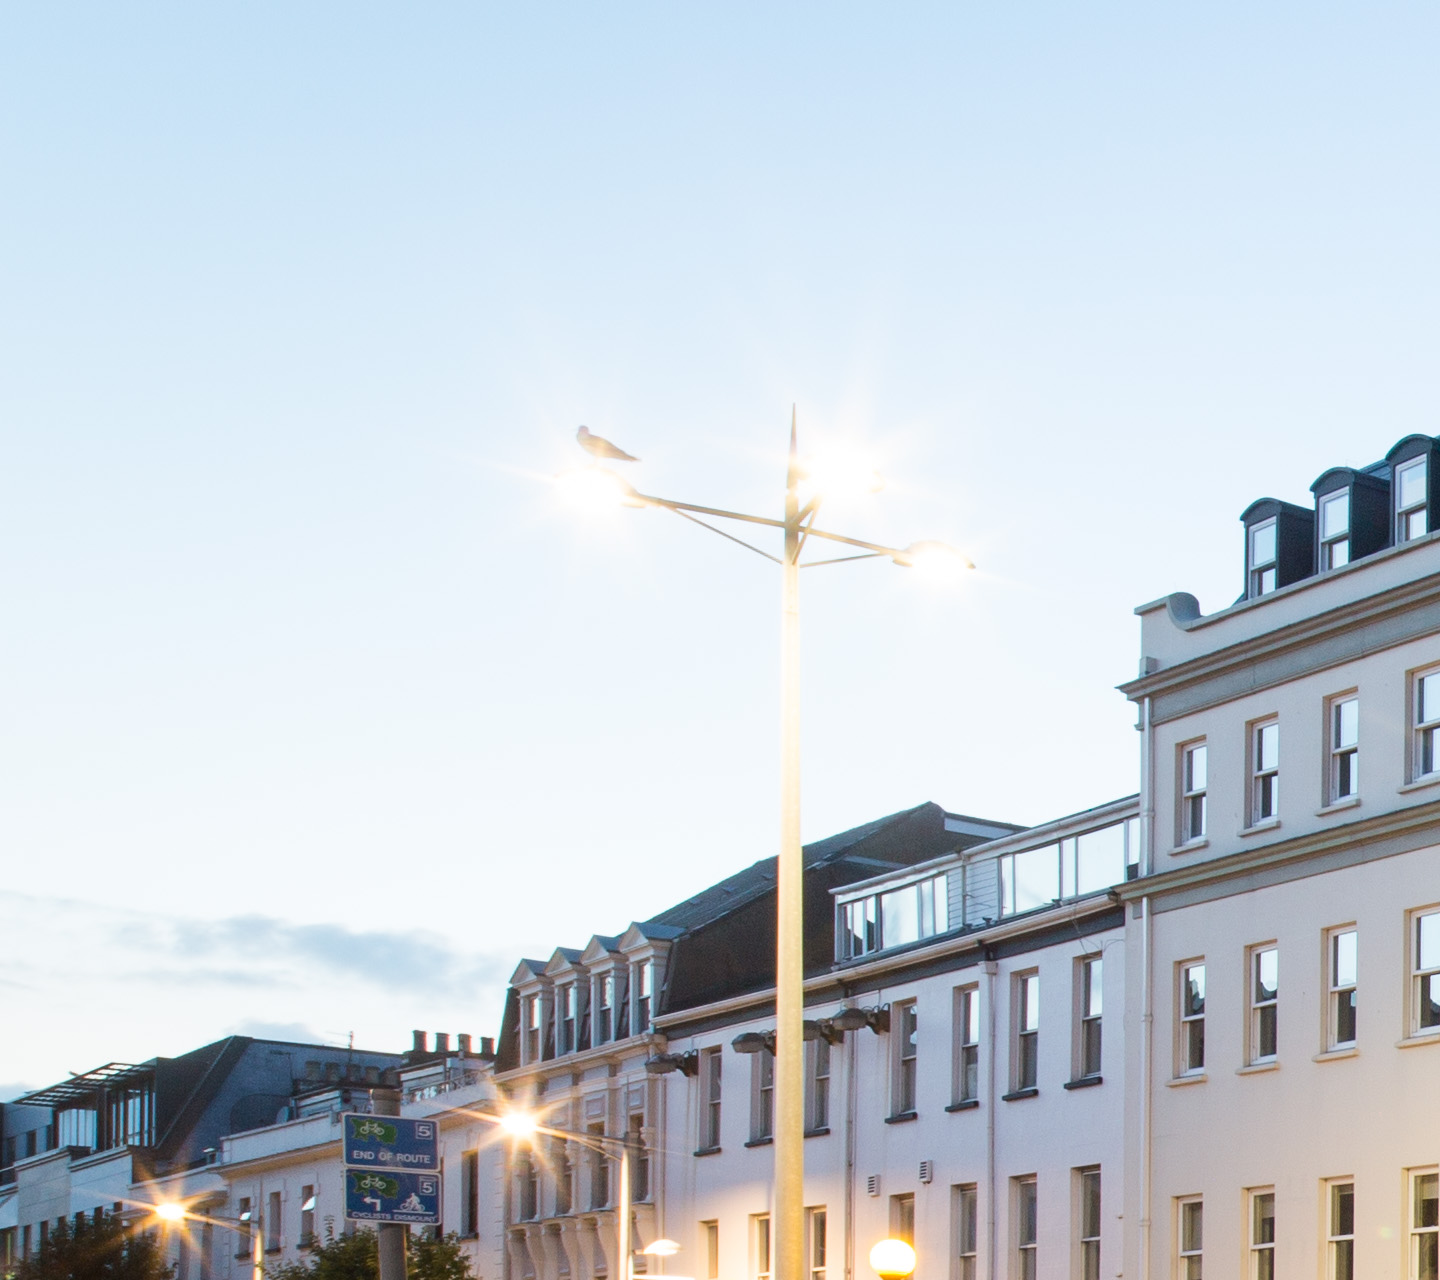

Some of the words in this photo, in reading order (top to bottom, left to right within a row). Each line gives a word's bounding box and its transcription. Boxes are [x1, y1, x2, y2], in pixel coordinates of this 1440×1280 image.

[418, 1125, 431, 1137] 5
[353, 1150, 375, 1160] END
[378, 1151, 393, 1161] OF
[396, 1153, 431, 1164] ROUTE
[422, 1182, 433, 1193] 5
[351, 1211, 392, 1220] CYCLISTS
[393, 1214, 437, 1223] DISMOUNT
